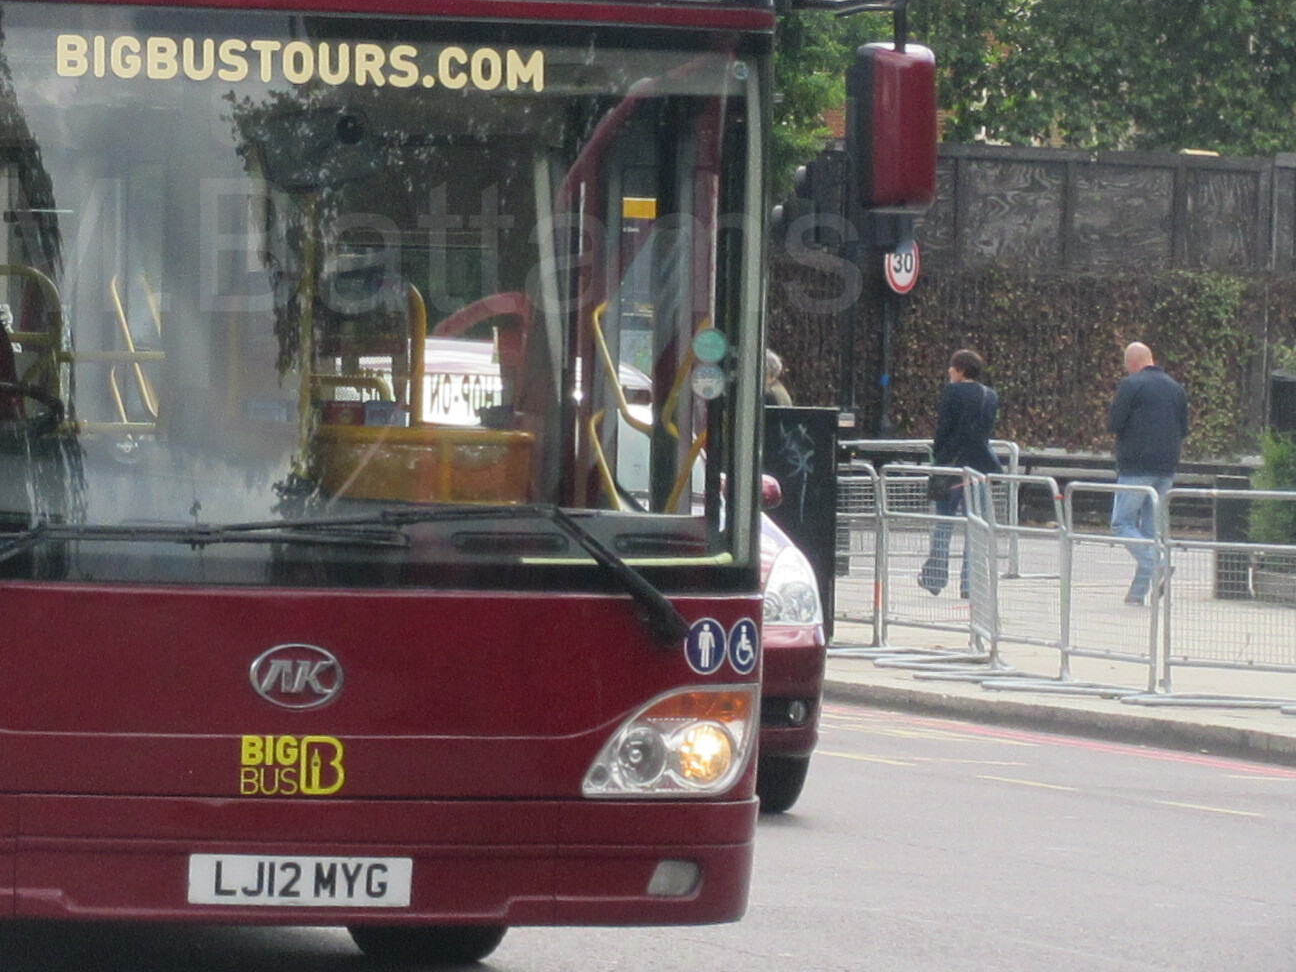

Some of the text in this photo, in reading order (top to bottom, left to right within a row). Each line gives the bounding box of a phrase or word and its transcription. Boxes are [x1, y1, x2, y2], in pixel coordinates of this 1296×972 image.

[55, 33, 545, 93] BIGBUSTOURS.COM
[893, 253, 914, 274] 30
[241, 734, 299, 766] BIG
[240, 767, 298, 795] BUS
[214, 860, 389, 899] LJ12 MYG
